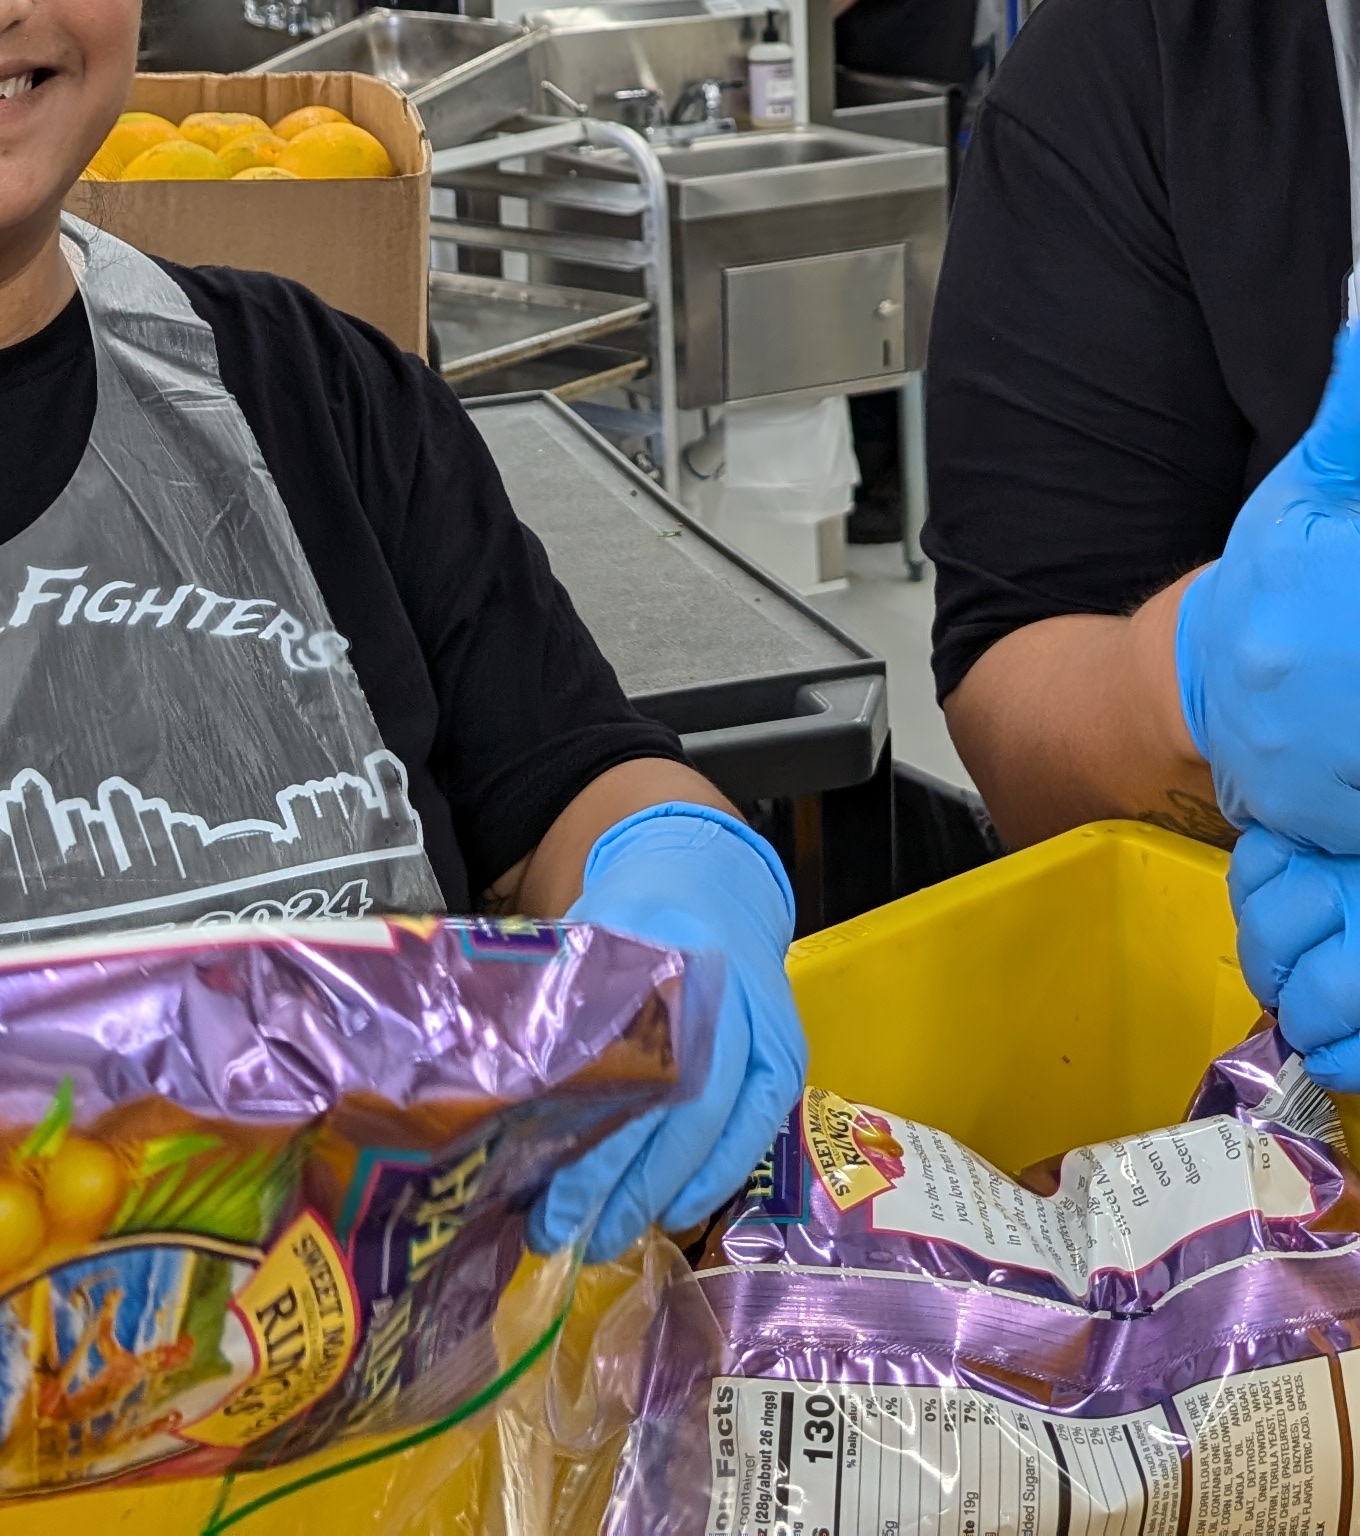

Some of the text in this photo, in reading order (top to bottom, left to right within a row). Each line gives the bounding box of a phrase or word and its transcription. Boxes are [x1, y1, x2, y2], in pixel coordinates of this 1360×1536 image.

[9, 565, 351, 672] FIGHTERS
[827, 1107, 871, 1167] RINGS
[1217, 1123, 1241, 1160] Open
[812, 1137, 852, 1197] SWEET
[1148, 1150, 1171, 1187] even
[924, 1182, 939, 1201] the
[948, 1176, 964, 1199] love
[959, 1201, 974, 1225] you
[982, 1222, 996, 1245] our
[1006, 1234, 1021, 1246] in
[293, 1233, 345, 1322] SWEET
[1237, 1383, 1251, 1423] SUGAR,
[1248, 1382, 1262, 1413] WHEY
[1259, 1379, 1273, 1413] YEAST
[1271, 1376, 1283, 1406] MILK,
[1282, 1374, 1296, 1412] GARLIC
[1294, 1371, 1307, 1412] SPICES.
[762, 1390, 778, 1428] rings)
[924, 1398, 937, 1422] 0%
[963, 1400, 977, 1424] 7%
[1185, 1397, 1200, 1420] RICE
[713, 1385, 736, 1478] Facts
[760, 1430, 773, 1445] 26
[803, 1395, 835, 1464] 130
[847, 1429, 858, 1457] Daily
[1072, 1426, 1084, 1445] 0%
[1090, 1427, 1104, 1445] 2%
[1110, 1424, 1123, 1443] 2%
[1255, 1417, 1267, 1465] POWDER,
[1266, 1414, 1277, 1450] YEAST,
[1277, 1409, 1291, 1479] (PASTEURIZED
[1211, 1443, 1221, 1464] ONE
[1235, 1440, 1243, 1457] OIL
[1245, 1431, 1256, 1488] DEXTROSE,
[1303, 1442, 1313, 1474] CITRIC
[755, 1447, 776, 1525] (28g/about
[1023, 1455, 1039, 1511] Sugars
[1200, 1454, 1210, 1490] FLOUR,
[1258, 1471, 1268, 1503] ONION
[1270, 1451, 1279, 1492] TORULA
[964, 1491, 979, 1516] 19g
[1199, 1491, 1210, 1517] CORN
[1211, 1466, 1221, 1517] (CONTAINS
[1234, 1471, 1244, 1511] CANOLA
[1280, 1482, 1290, 1518] CHEESE
[1292, 1480, 1302, 1506] SALT,
[1302, 1476, 1314, 1515] FLAVOR,
[1221, 1502, 1232, 1525] CORN
[1245, 1496, 1256, 1521] SALT,
